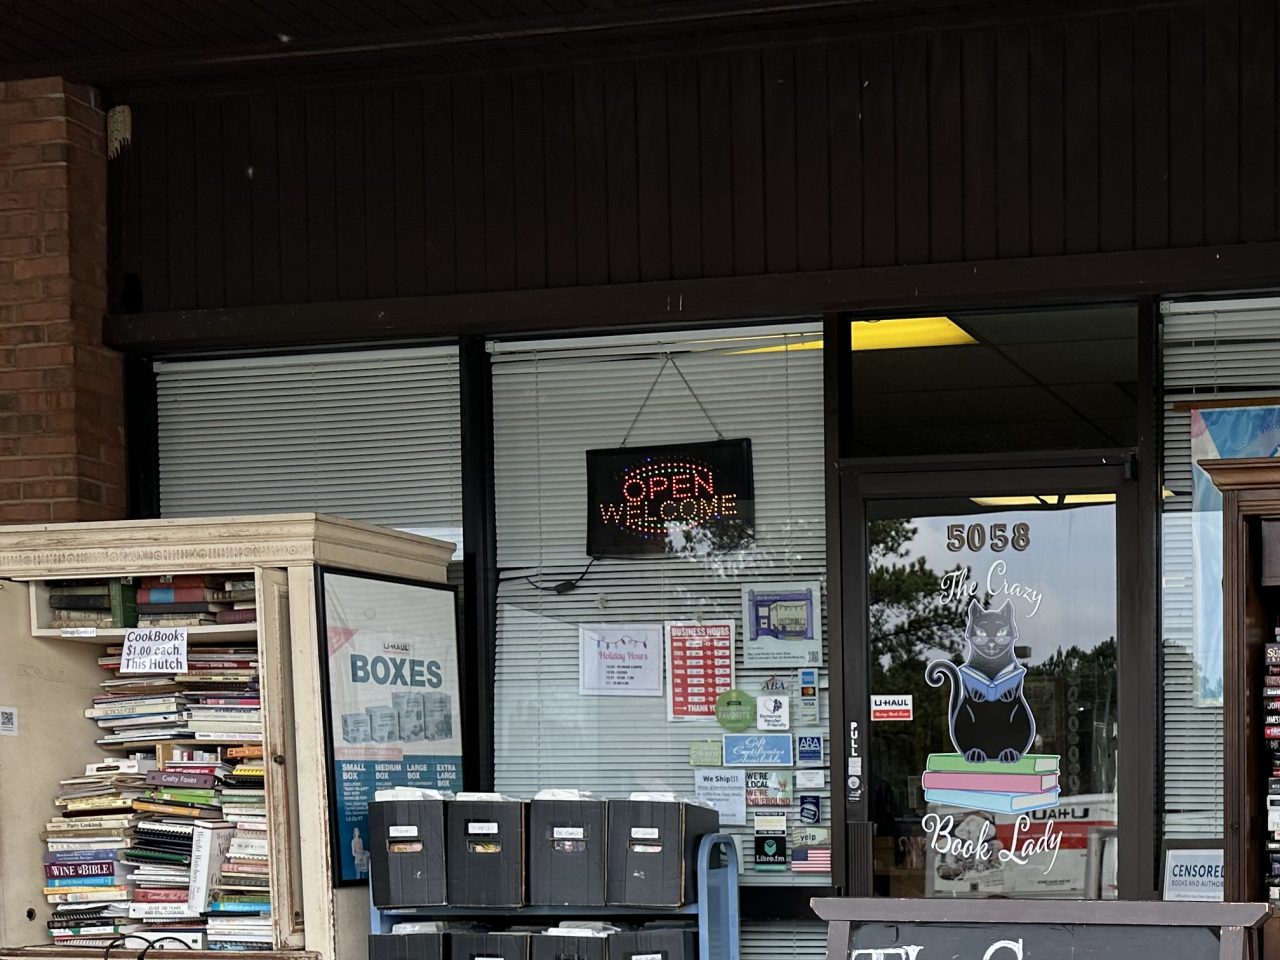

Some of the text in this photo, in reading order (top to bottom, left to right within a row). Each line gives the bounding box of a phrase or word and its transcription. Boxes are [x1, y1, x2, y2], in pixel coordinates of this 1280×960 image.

[623, 471, 714, 502] OPEN
[600, 494, 737, 524] WELCOME
[947, 523, 1031, 552] 5058
[939, 560, 1043, 618] The Crazy
[127, 630, 185, 642] CookBooks
[672, 627, 729, 636] BUSINESS HOURS
[126, 644, 182, 656] $1.00 each.
[599, 651, 648, 662] Holiday Hours
[125, 658, 183, 670] This Hutch
[351, 654, 442, 688] BOXES
[762, 682, 785, 690] ABA
[874, 699, 909, 707] U-HAUL
[688, 705, 708, 713] THANK
[746, 736, 765, 746] Gift
[800, 739, 819, 748] ABA
[850, 722, 858, 756] PULL
[733, 745, 784, 755] Certificates
[342, 763, 366, 771] SMALL
[162, 774, 180, 785] Crafty
[343, 771, 358, 780] BOX
[376, 771, 389, 780] BOX
[407, 771, 420, 780] BOX
[437, 771, 456, 779] LARGE
[715, 775, 738, 783] Ship!!!
[747, 772, 768, 780] WE'RE
[437, 779, 450, 788] BOX
[800, 833, 816, 841] yelp
[922, 814, 1063, 875] Book Lady
[756, 854, 785, 862] Libro.fm
[52, 864, 110, 876] WINE BIBLE
